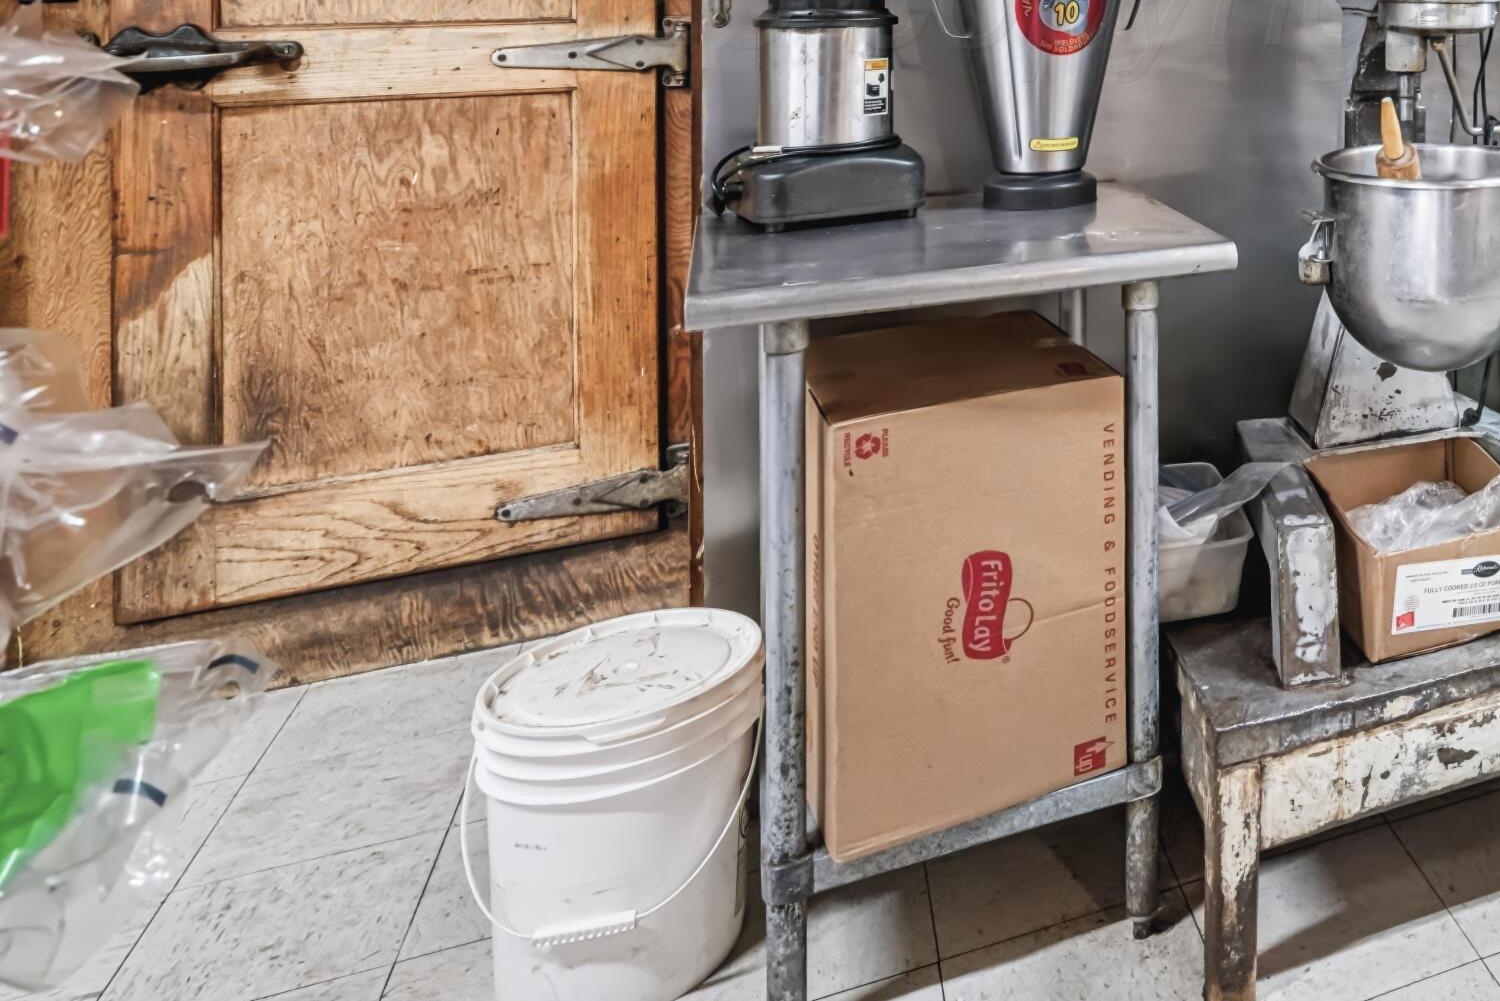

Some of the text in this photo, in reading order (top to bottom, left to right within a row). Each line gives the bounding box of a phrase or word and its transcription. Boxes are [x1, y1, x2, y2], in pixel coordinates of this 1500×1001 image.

[1053, 0, 1081, 27] 10
[1102, 421, 1118, 724] VENDING & FOODSERVICE
[1424, 586, 1443, 595] FULLY
[1443, 583, 1469, 592] COOKED
[938, 596, 961, 665] Good fun!
